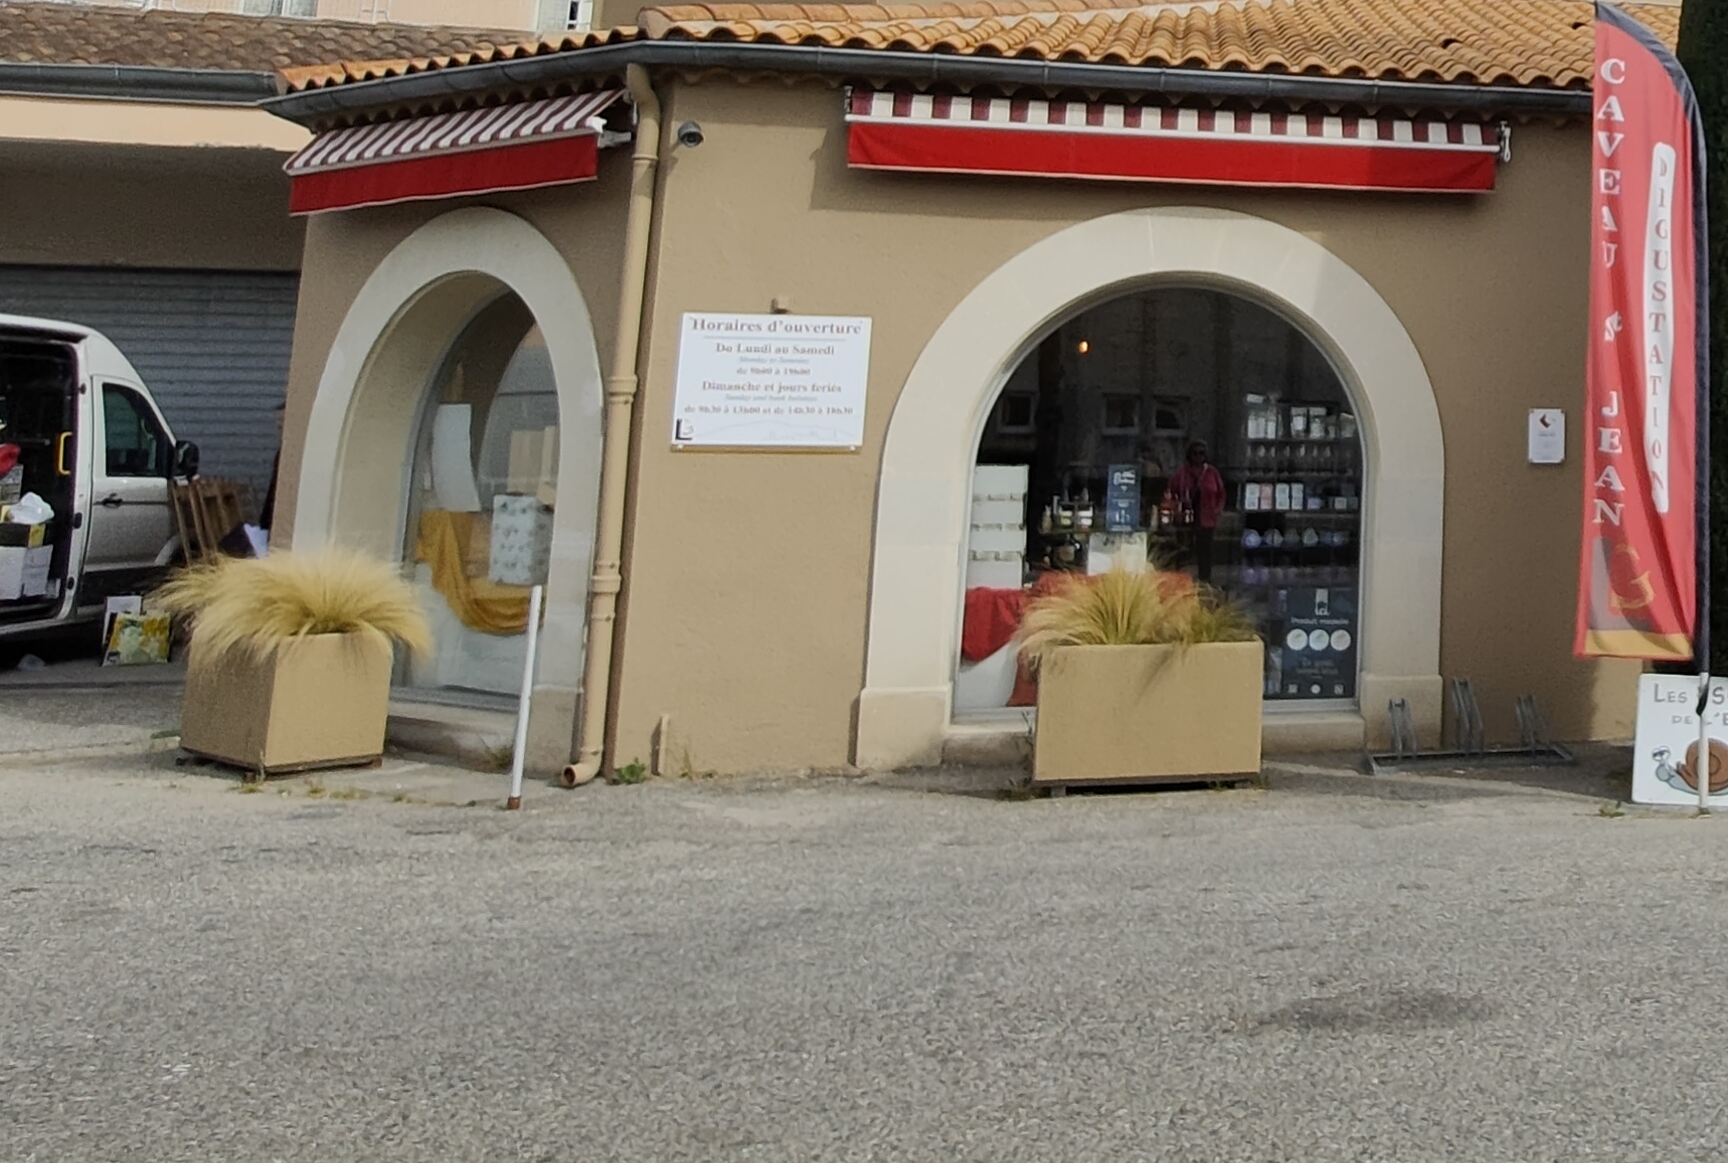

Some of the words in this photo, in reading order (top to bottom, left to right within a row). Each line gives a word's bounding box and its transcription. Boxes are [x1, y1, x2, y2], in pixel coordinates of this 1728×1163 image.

[1597, 58, 1626, 269] CAVEAU
[691, 318, 763, 332] Horaires
[767, 320, 862, 335] d'ouverture
[737, 342, 772, 353] Lundi
[793, 344, 835, 356] Samedi
[702, 379, 761, 392] Dimanche
[777, 381, 808, 394] jours
[1592, 390, 1625, 527] JEAN
